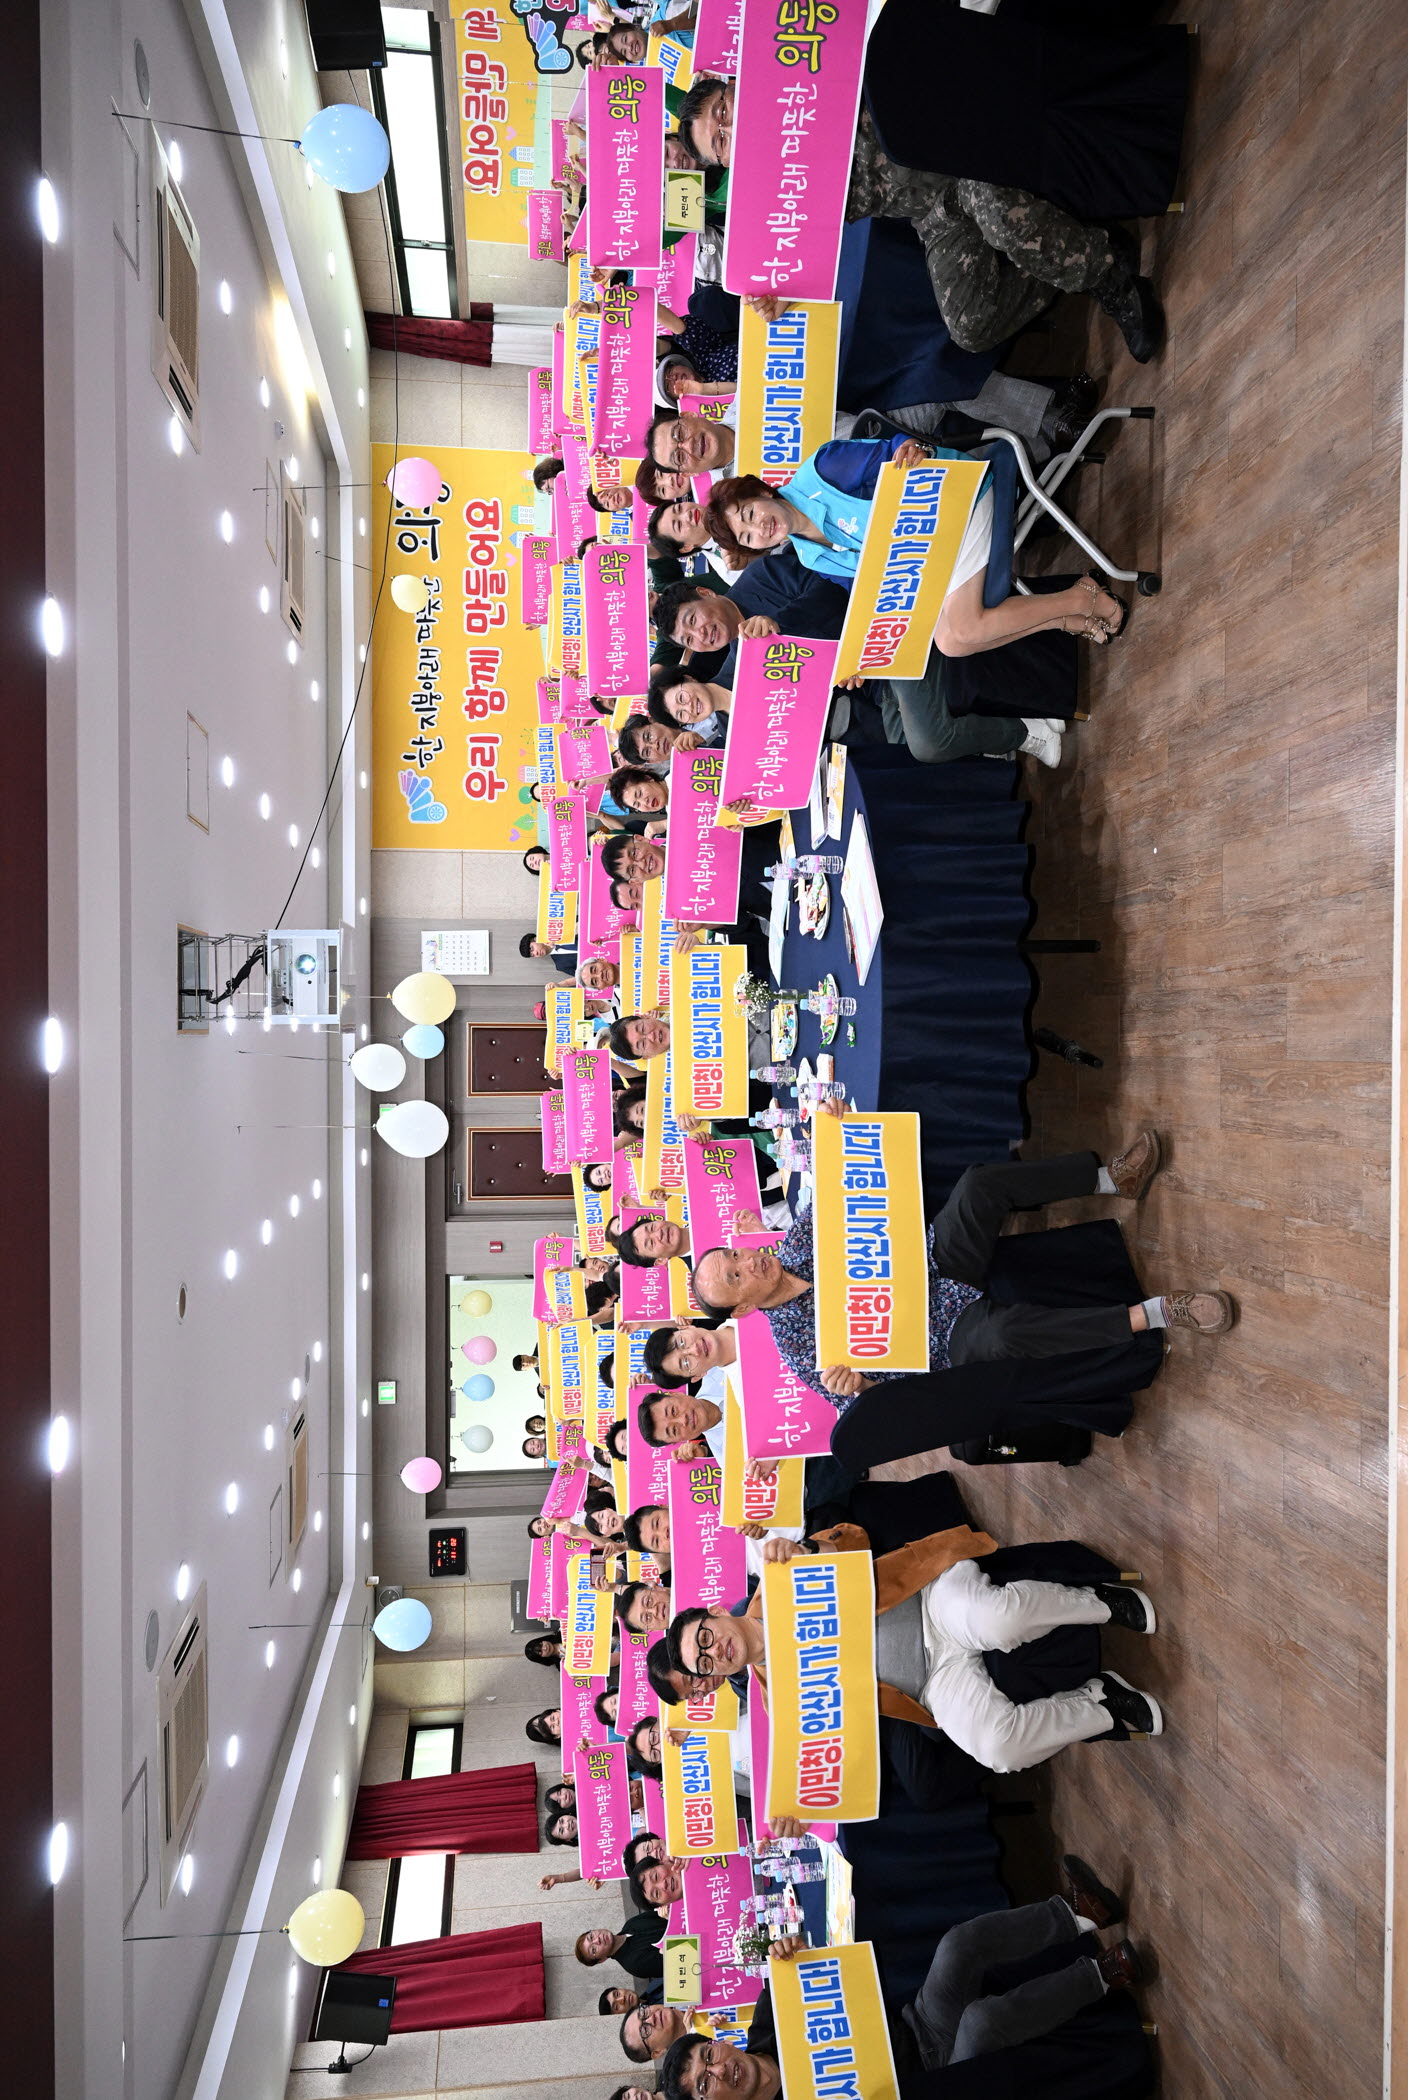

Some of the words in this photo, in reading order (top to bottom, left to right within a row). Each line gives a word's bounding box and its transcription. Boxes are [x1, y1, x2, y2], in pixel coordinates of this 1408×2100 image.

[607, 74, 647, 124] 와동
[776, 82, 818, 158] 따뜻한
[612, 128, 639, 175] 따뜻한
[613, 179, 638, 235] 지붕아래
[766, 164, 809, 251] 지붕아래
[604, 239, 639, 260] 한
[750, 257, 803, 288] 한
[602, 287, 638, 328] 와동
[575, 317, 600, 350] 합니다!
[765, 313, 804, 381] 합니다!
[606, 333, 630, 377] 따뜻한
[605, 378, 631, 429] 지붕아래
[598, 432, 631, 452] 한
[763, 387, 799, 463] 안산시가
[893, 469, 946, 536] 합니다!
[465, 500, 505, 632] 만들어요
[531, 539, 551, 561] 와동
[533, 563, 548, 583] 따뜻한
[562, 564, 582, 596] 합니다!
[599, 551, 630, 586] 와동
[875, 541, 929, 613] 안산시가
[534, 585, 548, 610] 지붕아래
[604, 590, 626, 626] 따뜻한
[531, 611, 548, 622] 한
[563, 598, 582, 636] 안산시가
[563, 639, 582, 670] 이민청!
[605, 628, 628, 671] 지붕아래
[859, 616, 908, 669] 이민청!
[763, 642, 814, 682] 와동
[413, 648, 440, 727] 지붕아래
[465, 650, 505, 718] 함께
[601, 674, 630, 691] 한
[570, 704, 590, 714] 한
[765, 688, 797, 728] 따뜻한
[403, 737, 442, 767] 한
[538, 727, 555, 752] 합니다!
[755, 730, 789, 777] 지붕아래
[466, 736, 505, 799] 우리
[540, 754, 556, 784] 안산시가
[744, 781, 784, 800] 한
[553, 800, 576, 822] 와동
[560, 824, 576, 846] 따뜻한
[560, 848, 577, 876] 지붕아래
[690, 843, 716, 893] 지붕아래
[557, 877, 576, 888] 한
[682, 895, 715, 915] 한
[549, 919, 564, 942] 이민청!
[690, 953, 720, 999] 합니다!
[556, 991, 571, 1015] 합니다!
[556, 1016, 571, 1044] 안산시가
[691, 1003, 721, 1059] 안산시가
[574, 1053, 599, 1080] 와동
[577, 1083, 595, 1110] 따뜻한
[692, 1063, 722, 1109] 이민청!
[580, 1110, 595, 1144] 지붕아래
[577, 1147, 598, 1159] 한
[703, 1146, 737, 1178] 와동
[842, 1124, 886, 1190] 합니다!
[586, 1194, 602, 1224] 안산시가
[710, 1182, 736, 1216] 따뜻한
[545, 1240, 565, 1261] 와동
[588, 1226, 605, 1252] 이민청!
[846, 1196, 890, 1280] 안산시가
[636, 1304, 663, 1317] 한
[848, 1287, 891, 1357] 이민청!
[561, 1326, 579, 1353] 합니다!
[563, 1355, 580, 1387] 안산시가
[564, 1388, 582, 1415] 이민청!
[566, 1428, 584, 1447] 와동
[768, 1421, 812, 1447] 한
[689, 1464, 722, 1505] 와동
[575, 1593, 596, 1632] 안산시가
[794, 1566, 838, 1641] 합니다!
[572, 1635, 594, 1669] 이민청!
[575, 1692, 592, 1718] 따뜻한
[632, 1681, 649, 1718] 지붕아래
[799, 1646, 842, 1733] 안산시가
[588, 1751, 613, 1781] 와동
[679, 1736, 711, 1794] 안산시가
[799, 1739, 842, 1806] 이민청!
[593, 1784, 612, 1814] 따뜻한
[599, 1817, 617, 1856] 지붕아래
[684, 1798, 714, 1846] 이민청!
[595, 1859, 617, 1874] 한
[709, 1873, 732, 1917] 따뜻한
[712, 1978, 742, 1999] 한
[799, 1960, 852, 2042] 합니다!
